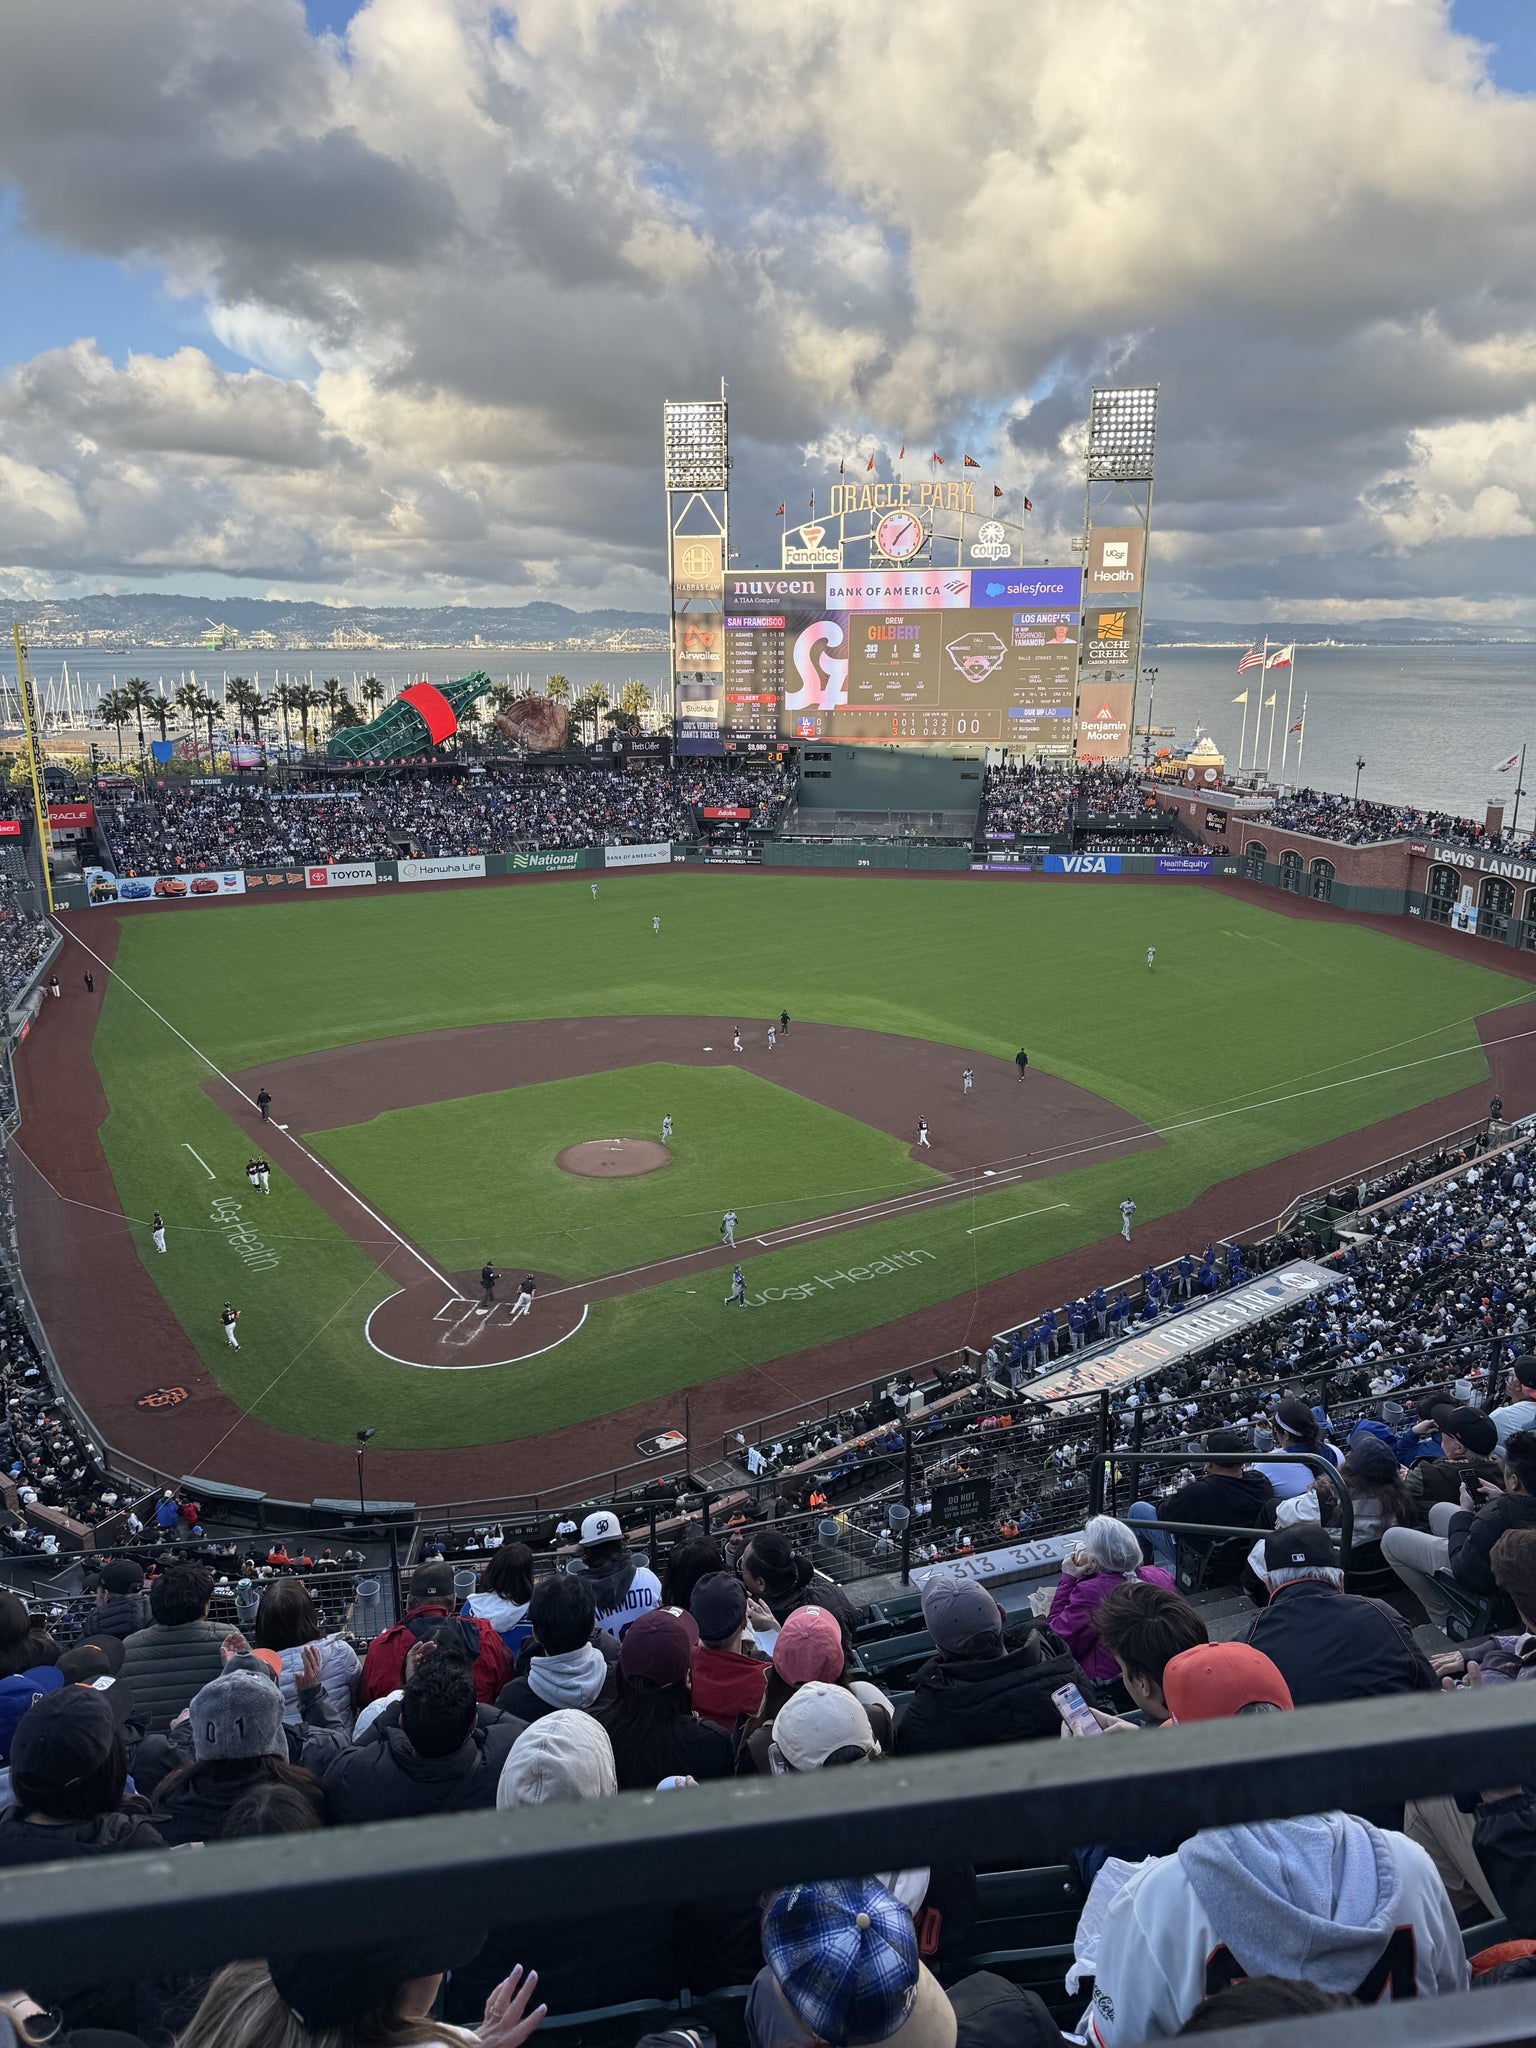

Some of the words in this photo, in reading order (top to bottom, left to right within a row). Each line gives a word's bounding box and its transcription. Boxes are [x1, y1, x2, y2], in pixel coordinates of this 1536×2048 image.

[830, 483, 911, 515] ORACLE
[919, 481, 975, 514] PARK
[973, 543, 1009, 557] coupa
[1106, 550, 1125, 560] UCSF
[786, 549, 839, 562] Fanatics
[1094, 570, 1134, 581] Health
[734, 580, 816, 595] nuveen
[830, 588, 862, 597] BANK
[866, 587, 881, 596] OF
[884, 586, 940, 596] AMERICA
[1007, 582, 1064, 597] salesforce
[727, 618, 741, 627] SAN
[743, 617, 783, 626] FRANCISCO
[885, 617, 904, 625] DREW
[1021, 614, 1035, 623] LOS
[867, 625, 921, 640] GILBERT
[1015, 631, 1046, 639] YOSHINOBU
[1015, 638, 1046, 646] YAMAMOTO
[1089, 640, 1130, 649] CACHE
[864, 643, 878, 653] .313
[914, 644, 920, 652] 2
[679, 651, 720, 660] Airwallex
[1089, 650, 1128, 658] CREEK
[686, 704, 714, 713] StubHub
[683, 722, 696, 730] 100%
[697, 722, 718, 730] VERIFIED
[958, 720, 966, 734] 0
[971, 720, 980, 733] 0
[1081, 721, 1126, 732] Benjamin
[681, 731, 698, 739] GIANTS
[700, 730, 720, 739] TICKETS
[1087, 731, 1119, 740] Moore
[25, 680, 35, 717] ROOT
[31, 736, 41, 765] THA
[36, 767, 48, 819] CHIKIN
[645, 742, 660, 751] Coffee
[49, 811, 87, 821] RACLE
[528, 852, 578, 866] National
[420, 866, 460, 874] Hanwha
[462, 862, 481, 872] Life
[558, 863, 576, 871] Rental
[1058, 856, 1106, 873] VISA
[1160, 860, 1208, 869] HealthEquity
[331, 870, 372, 880] TOYOTA
[54, 902, 70, 910] 339
[1409, 906, 1420, 915] 365
[210, 1196, 242, 1222] UCSF
[220, 1222, 282, 1272] Health
[744, 1283, 817, 1307] UCSF
[814, 1250, 936, 1290] Health
[1129, 1342, 1170, 1360] TO
[1160, 1309, 1240, 1348] ORACLE
[1234, 1289, 1284, 1316] PARK
[948, 1496, 958, 1505] DO
[961, 1492, 976, 1502] NOT
[950, 1556, 996, 1579] 313
[1008, 1543, 1058, 1566] 312
